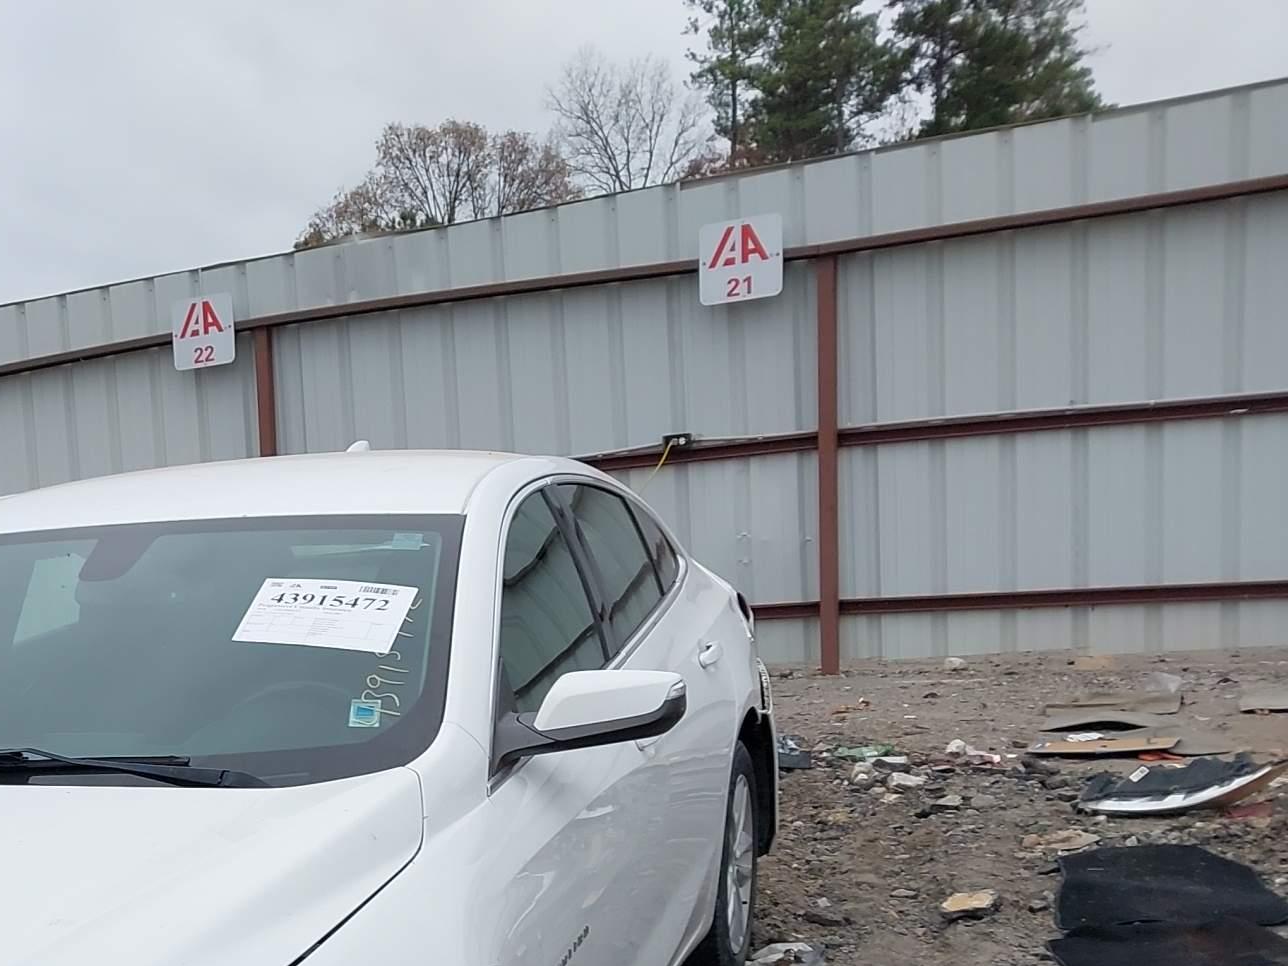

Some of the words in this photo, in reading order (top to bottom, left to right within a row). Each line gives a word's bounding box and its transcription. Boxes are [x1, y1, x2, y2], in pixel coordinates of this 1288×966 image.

[726, 275, 752, 297] 21
[194, 345, 215, 364] 22
[271, 592, 390, 611] 43915472
